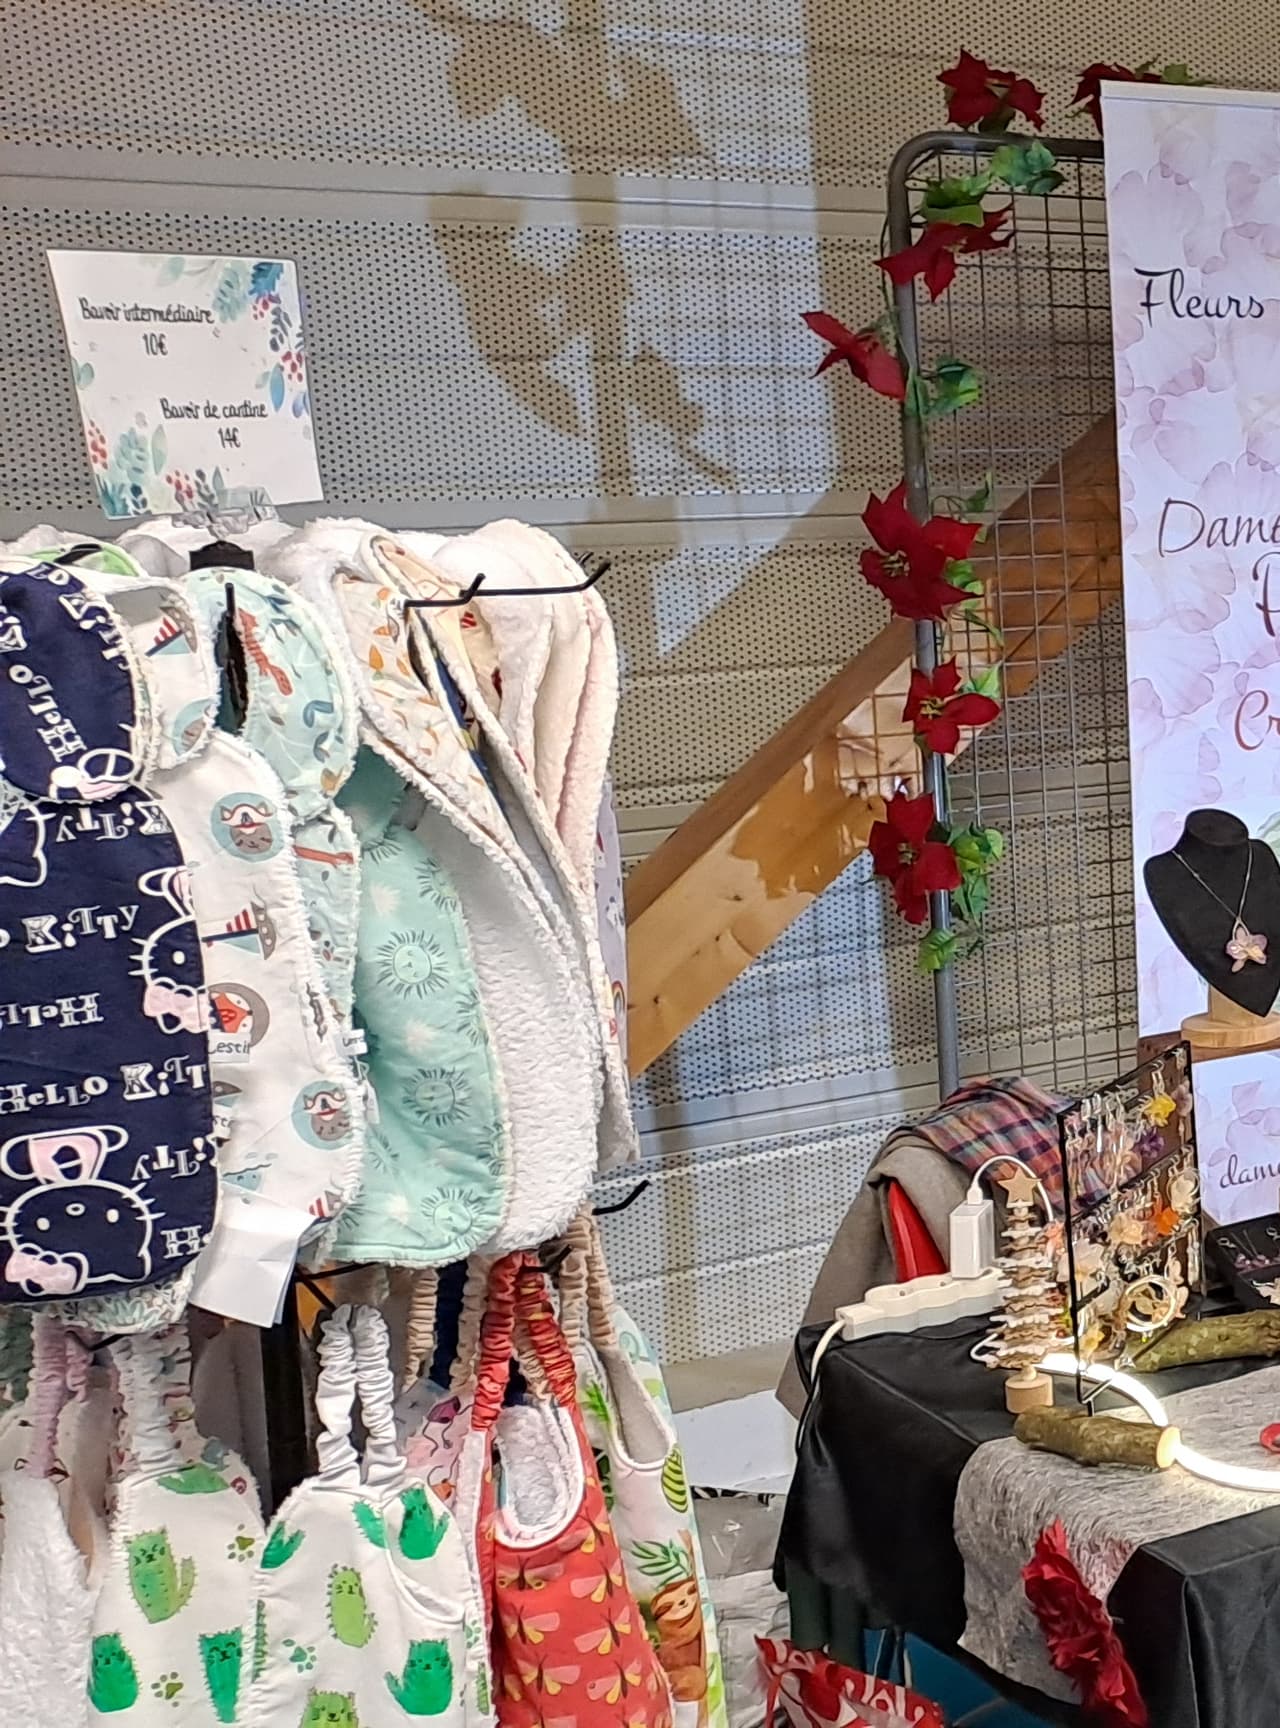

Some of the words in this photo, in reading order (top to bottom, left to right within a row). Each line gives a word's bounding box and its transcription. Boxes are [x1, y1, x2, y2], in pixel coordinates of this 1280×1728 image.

[1134, 268, 1265, 328] Fleurs
[78, 298, 121, 321] Bavoir
[123, 304, 215, 324] intermédiaire
[143, 332, 168, 356] 10€
[159, 398, 200, 419] Bavoir
[204, 400, 217, 418] de
[222, 402, 268, 419] cantine
[217, 427, 241, 449] 14€
